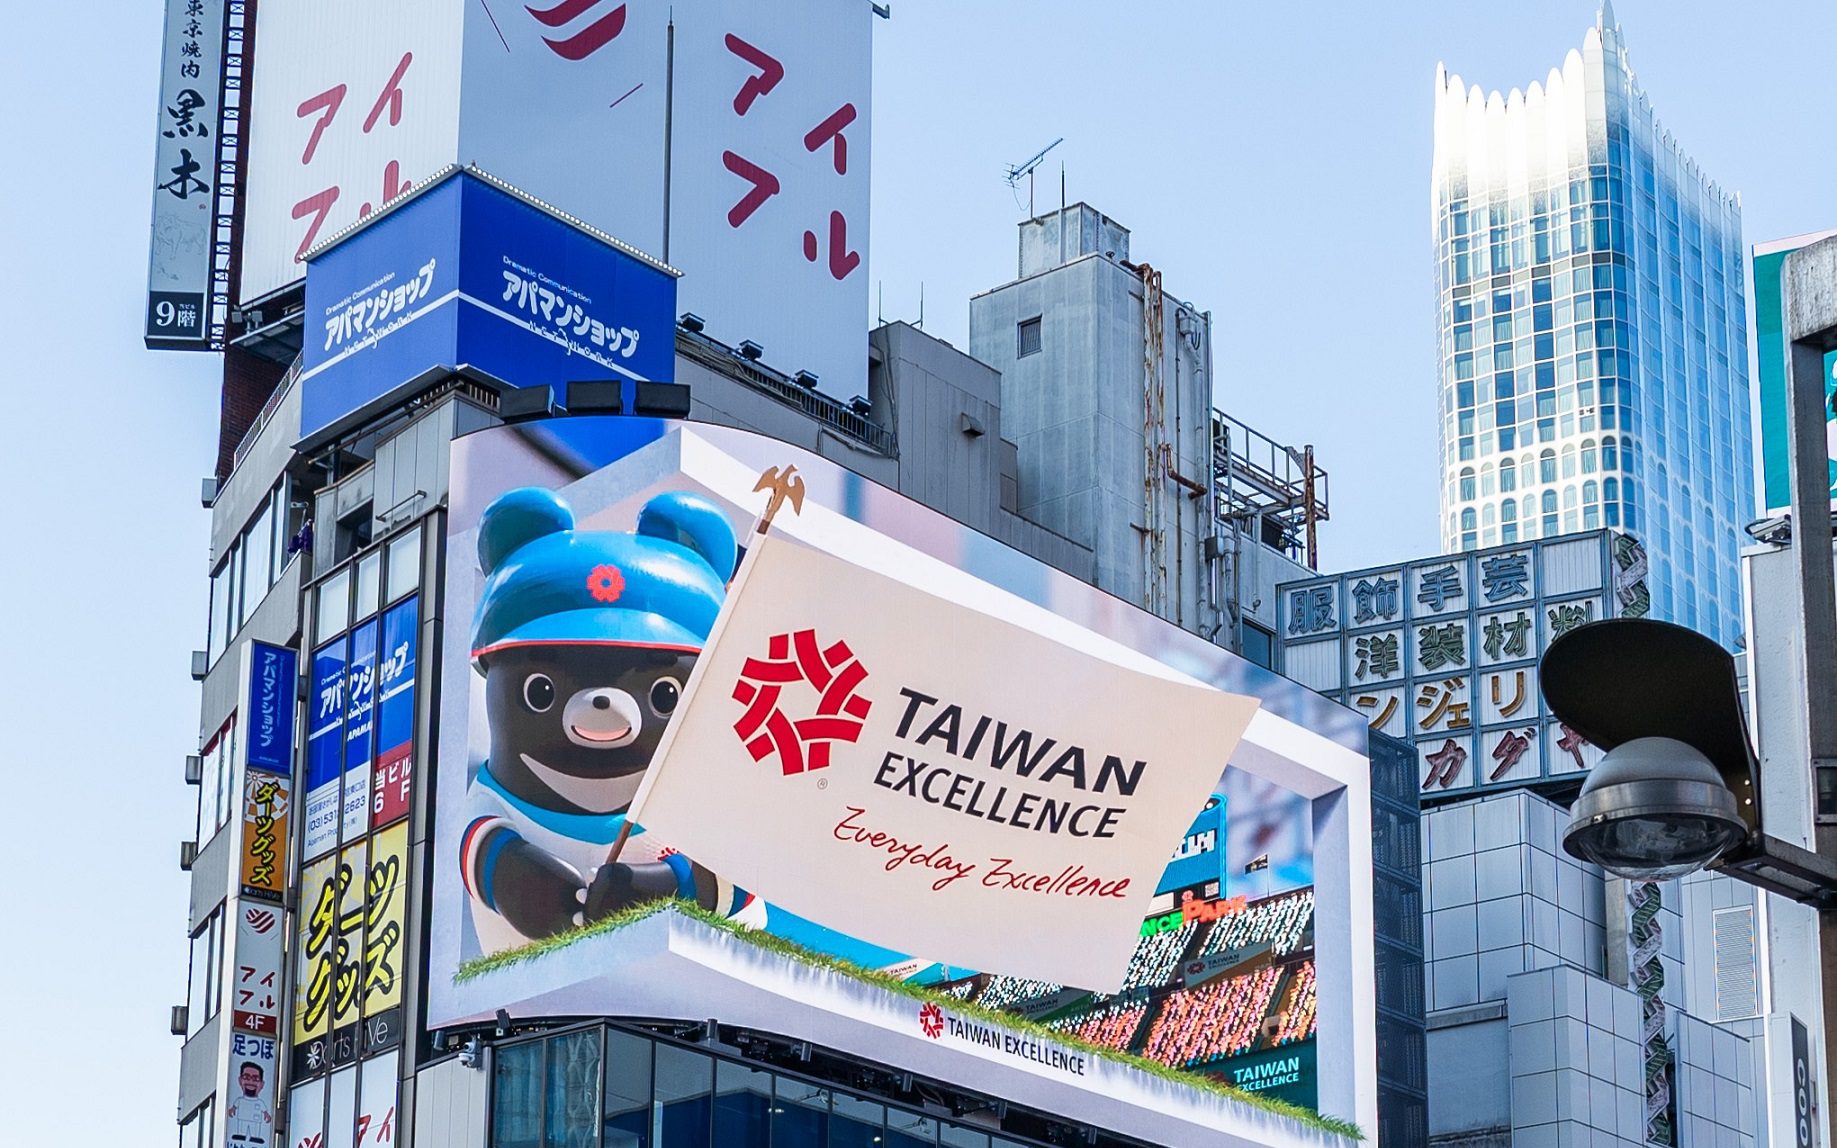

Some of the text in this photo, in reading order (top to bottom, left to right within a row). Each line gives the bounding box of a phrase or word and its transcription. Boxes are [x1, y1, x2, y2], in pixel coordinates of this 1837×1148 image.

[157, 89, 210, 200] 黒木
[296, 51, 413, 165] アイ
[724, 32, 857, 176] アイ
[722, 150, 861, 281] フル
[324, 257, 437, 352] アパマンショップ
[502, 270, 641, 359] アパマンショップ
[1288, 554, 1529, 634] 服飾手芸
[319, 641, 409, 719] アパンシップ
[1354, 600, 1594, 681] 洋装材料
[260, 651, 277, 747] アパマンショップ
[894, 687, 1147, 796] TAIWAN
[373, 783, 411, 814] 6 F
[374, 757, 412, 790] 当ビル
[873, 751, 1127, 839] EXCELLENCE
[1422, 721, 1589, 790] カダヤ
[250, 782, 280, 886] ダーツグッズ
[833, 806, 1131, 900] Everyday Excellence
[306, 853, 400, 961] ダーツ
[239, 965, 276, 988] アイ
[239, 989, 275, 1010] フル
[304, 919, 401, 1032] グッズ
[232, 1034, 275, 1061] 足つぼ
[245, 1014, 265, 1030] 4F
[948, 1016, 1085, 1077] TAIWAN EXCELLENCE
[1233, 1057, 1300, 1083] TAIWAN
[1796, 1056, 1809, 1148] COO
